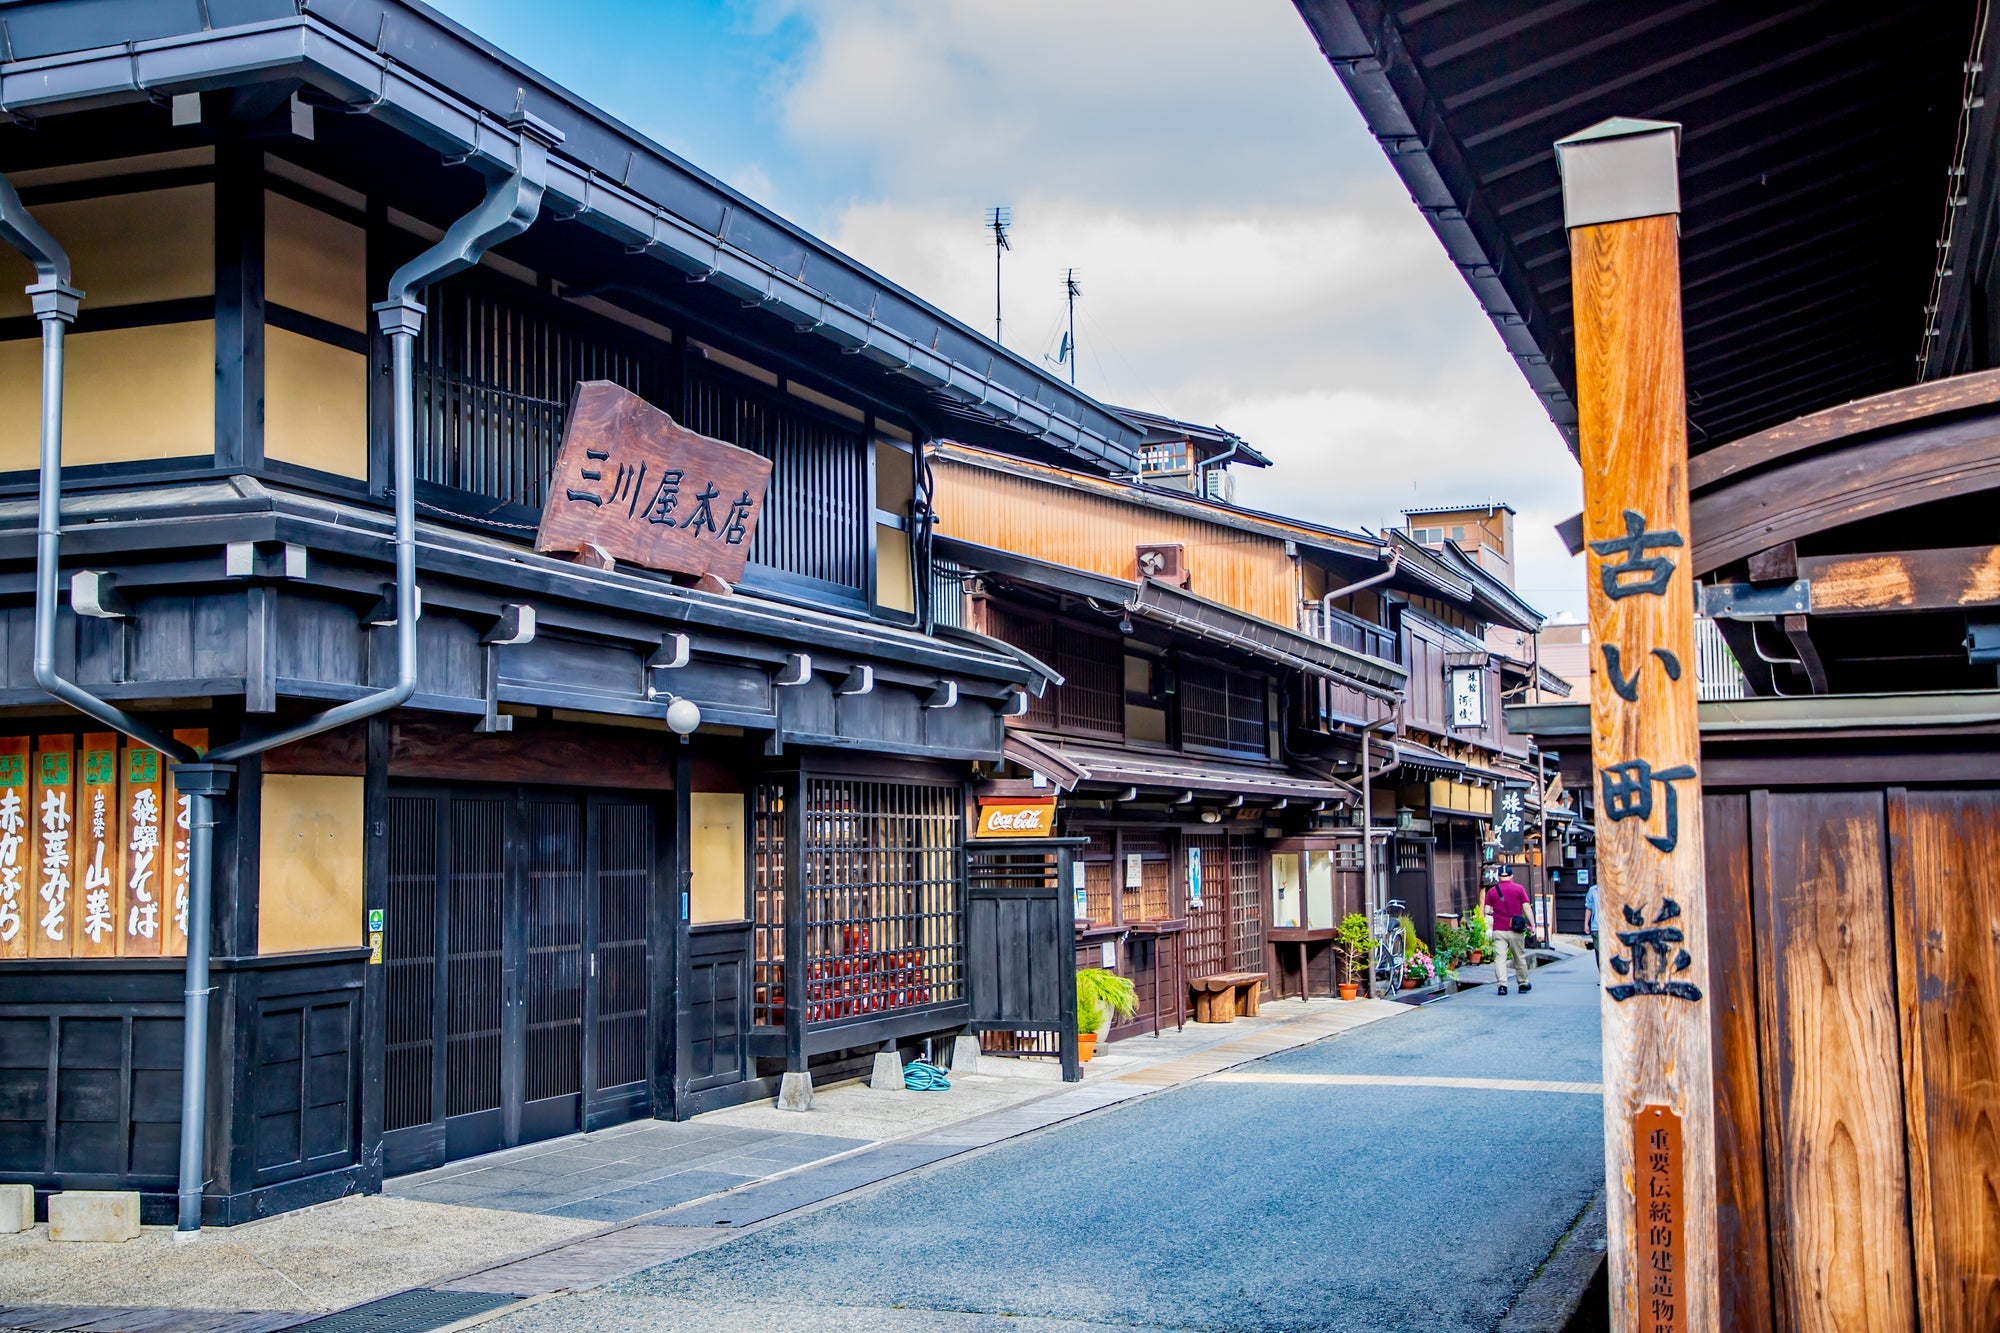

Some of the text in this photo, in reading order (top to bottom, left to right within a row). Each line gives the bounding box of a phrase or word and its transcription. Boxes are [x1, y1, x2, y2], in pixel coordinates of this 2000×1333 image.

[566, 448, 754, 545] 三川屋本店
[1589, 509, 1703, 1002] 古い町並
[987, 809, 1043, 831] Coca-Cola
[1501, 791, 1524, 833] 旅館
[0, 787, 24, 942] 赤かぶら
[40, 789, 71, 941] 朴葉みそ
[85, 840, 113, 944] 山菜
